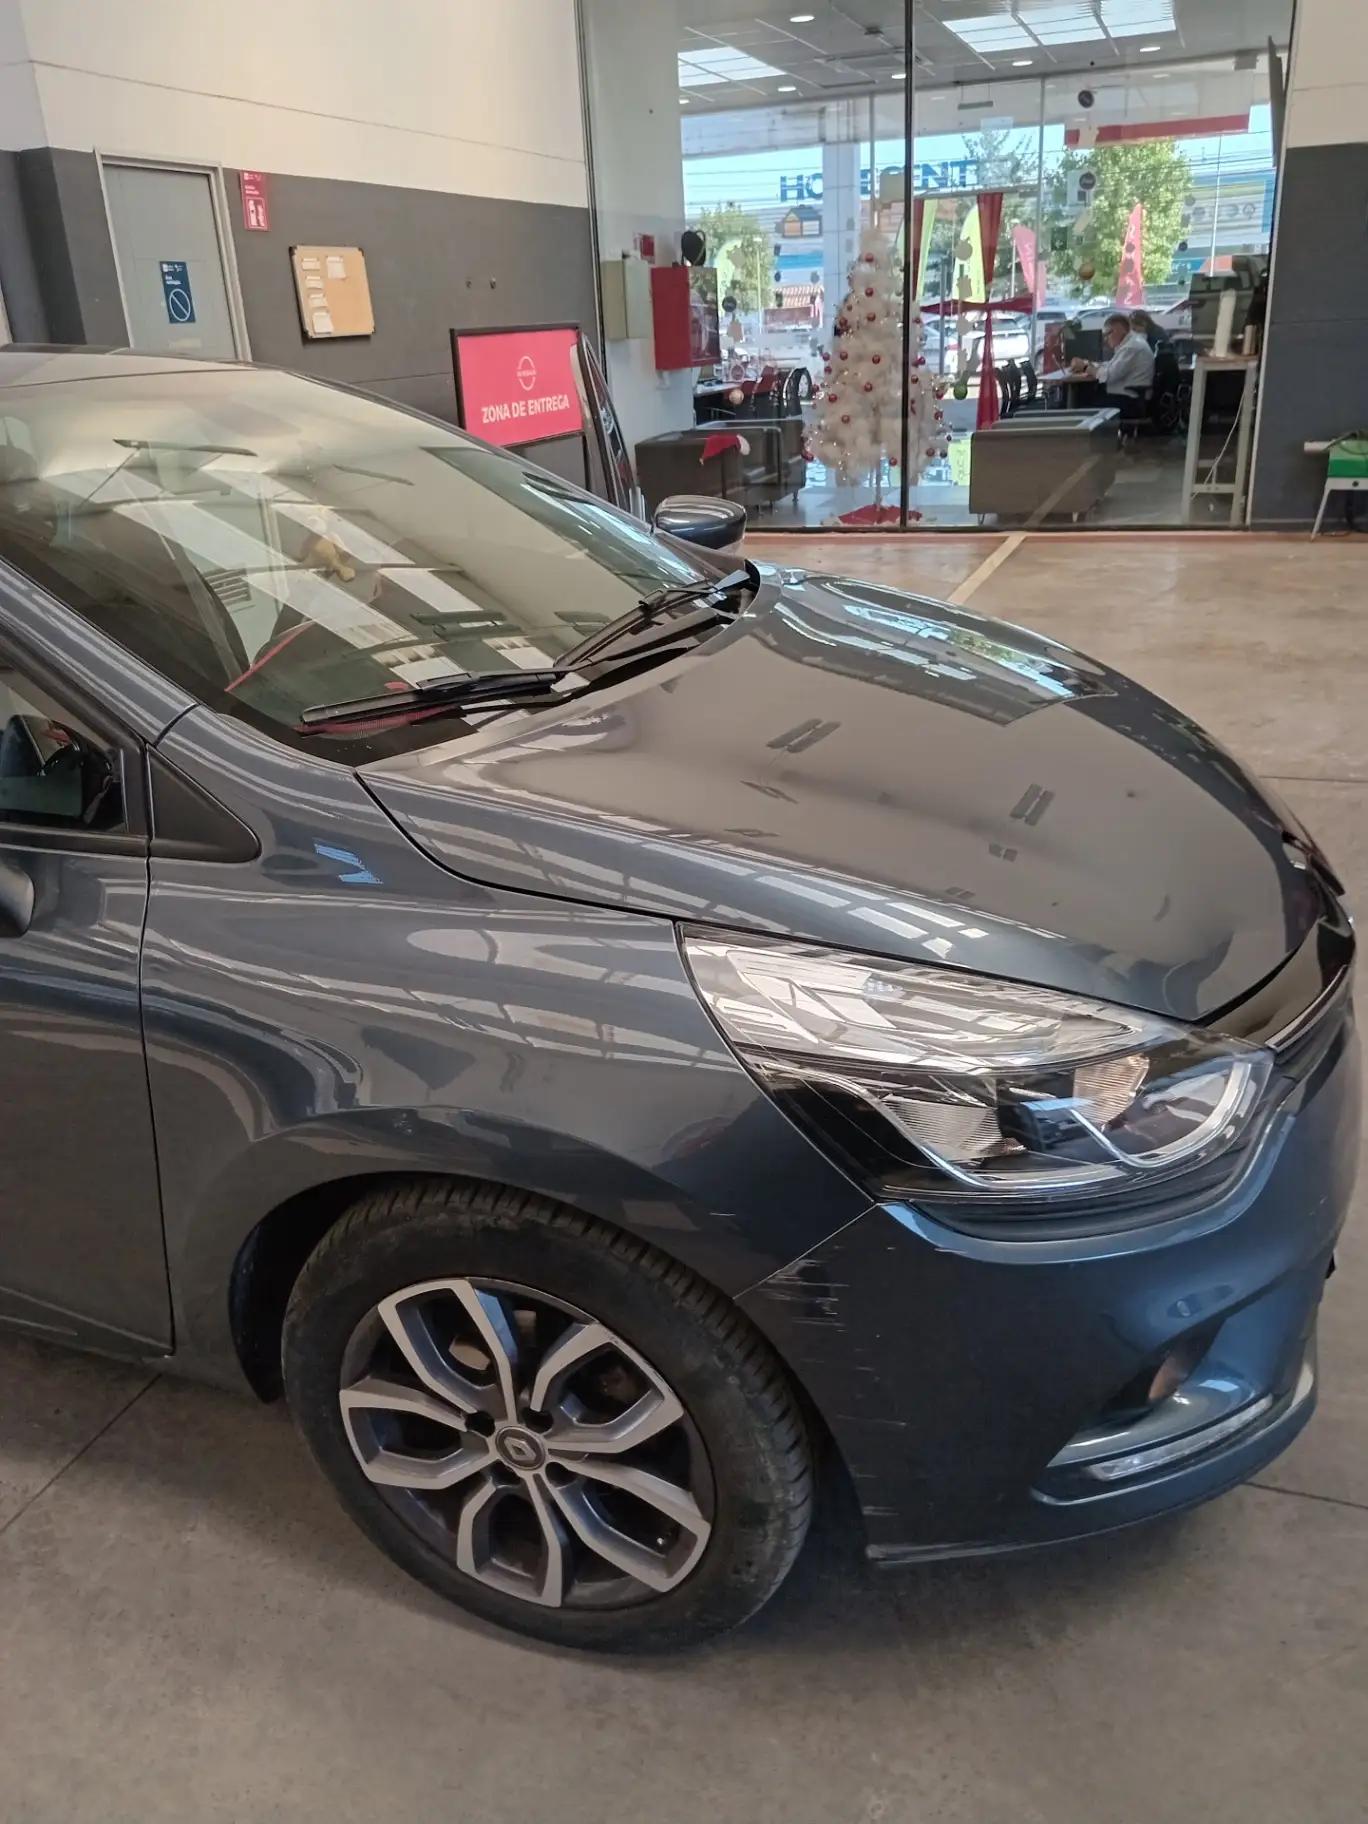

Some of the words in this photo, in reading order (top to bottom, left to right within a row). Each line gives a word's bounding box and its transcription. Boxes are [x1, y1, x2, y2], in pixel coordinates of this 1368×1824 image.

[481, 404, 511, 423] ZONA
[511, 400, 527, 418] DE
[528, 394, 569, 415] ENTREGA
